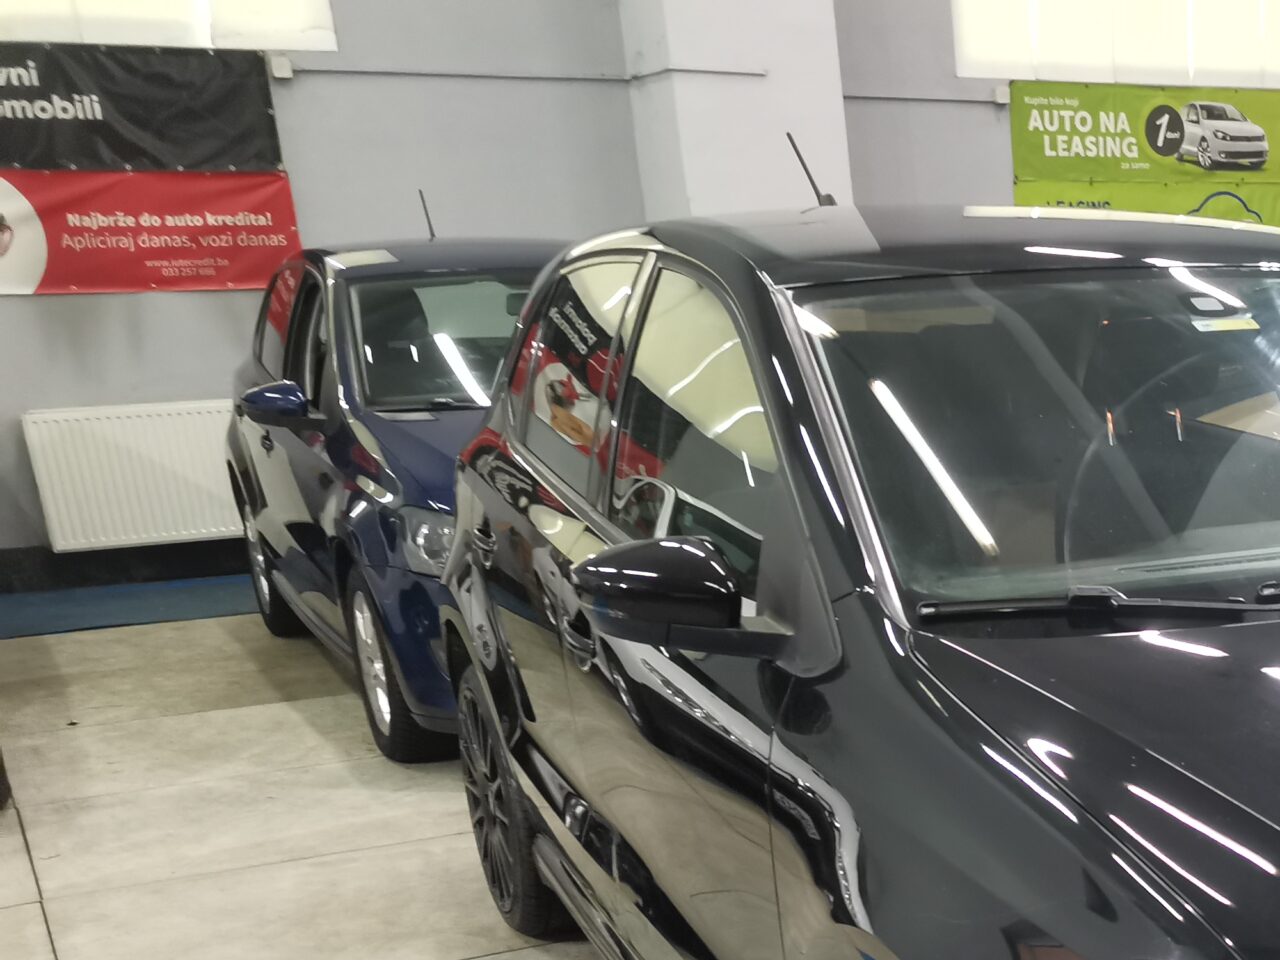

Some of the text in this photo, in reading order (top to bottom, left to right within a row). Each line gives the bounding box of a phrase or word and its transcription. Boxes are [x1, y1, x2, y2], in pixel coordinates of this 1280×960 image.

[0, 93, 104, 121] mobili
[1028, 109, 1131, 133] AUTO NA
[1155, 113, 1170, 147] 1
[1044, 135, 1139, 158] LEASING
[66, 212, 273, 230] Najbrže do auto kredita!
[61, 232, 288, 252] Apliciraj danas, vozi danas
